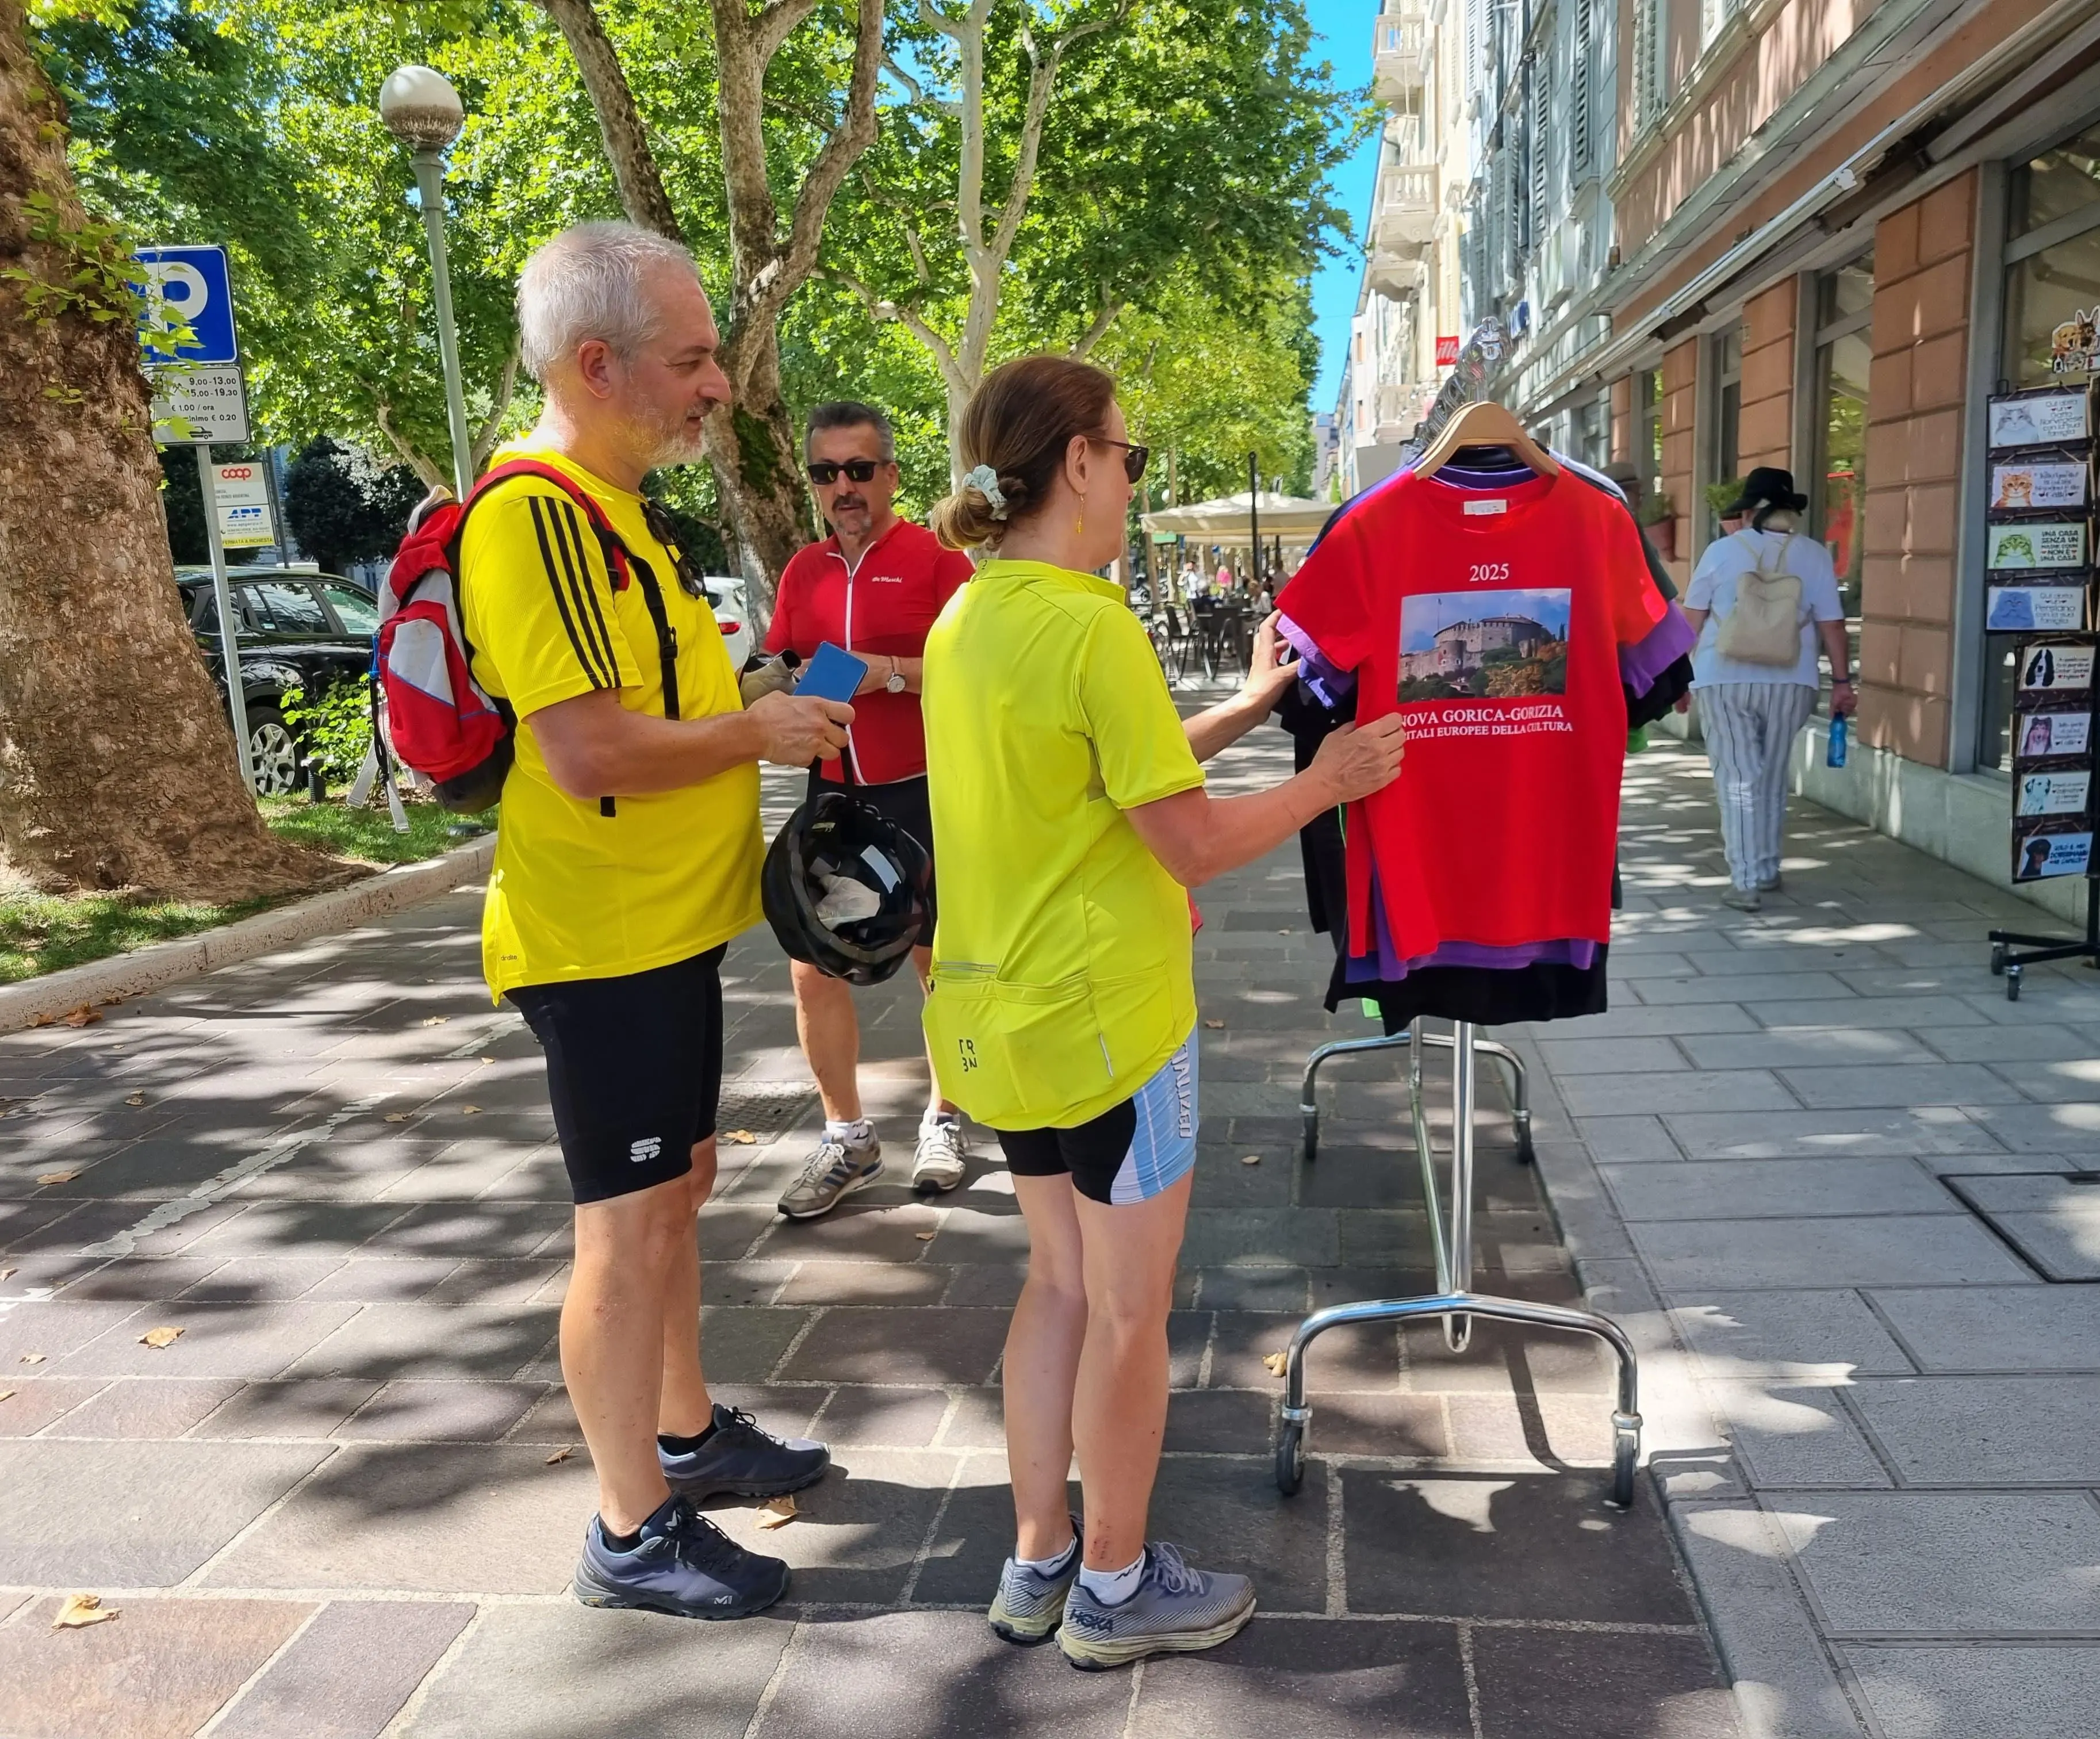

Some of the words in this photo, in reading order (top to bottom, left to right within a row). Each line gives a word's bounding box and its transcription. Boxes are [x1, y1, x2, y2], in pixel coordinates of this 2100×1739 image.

[1438, 341, 1458, 363] illy
[221, 468, 251, 480] coop
[1469, 563, 1509, 581] 2025
[1442, 704, 1563, 723] GORICA-GORIZIA
[1405, 728, 1435, 741] ITALI
[1437, 726, 1489, 737] EUROPEE
[1492, 724, 1526, 736] DELLA
[1527, 721, 1573, 733] CULTURA
[1070, 1608, 1114, 1633] HOKA
